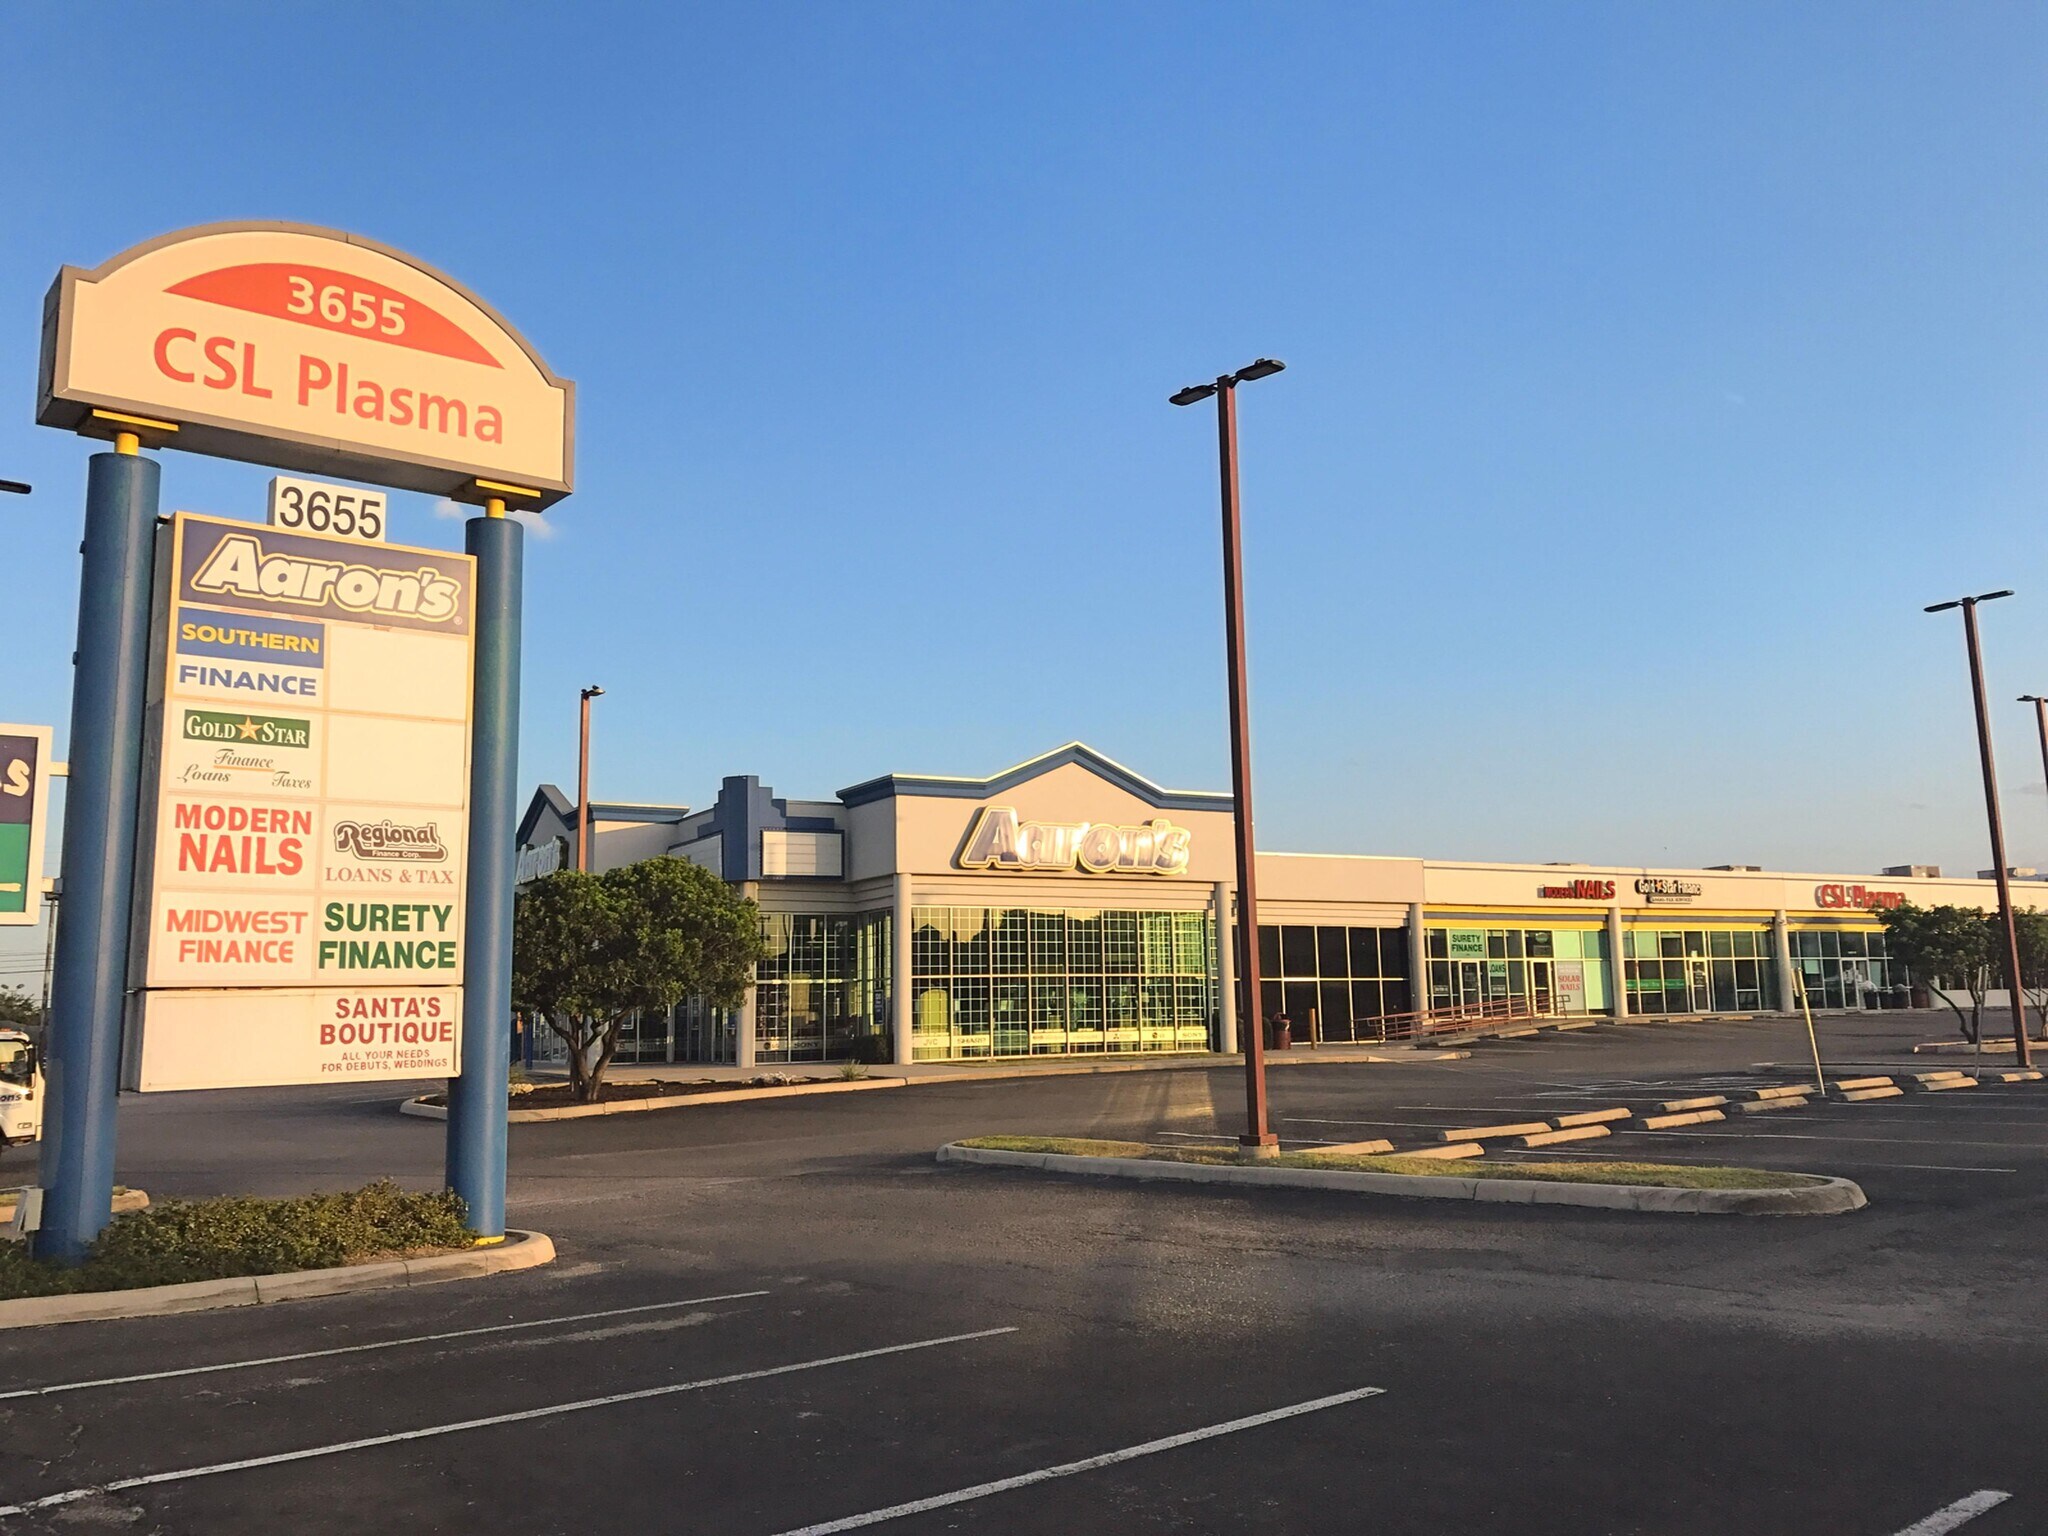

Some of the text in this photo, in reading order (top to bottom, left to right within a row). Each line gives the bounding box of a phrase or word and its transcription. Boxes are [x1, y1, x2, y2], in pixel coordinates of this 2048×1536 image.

[287, 276, 405, 336] 3655
[153, 327, 502, 444] CSL Plasma
[280, 487, 381, 539] 3655
[192, 534, 461, 622] Aaron's
[182, 624, 319, 654] SOUTHERN
[179, 665, 317, 696] FINANCE
[186, 715, 306, 745] GOLD STAR
[214, 748, 274, 769] Finance
[177, 764, 231, 783] Loans
[271, 771, 312, 789] Taxes
[175, 803, 312, 835] MODERN
[334, 820, 440, 851] Regional
[954, 806, 1190, 876] Aaron's
[178, 833, 303, 876] NAILS
[325, 867, 454, 884] LOANS & TAX
[1663, 880, 1677, 894] Star
[1574, 880, 1616, 899] NAILS
[1821, 884, 1851, 908] CSL
[166, 909, 308, 934] MIDWEST
[324, 902, 453, 932] SURETY
[1451, 943, 1483, 952] FINANCE
[1452, 934, 1481, 943] SURETY
[179, 940, 293, 963] FINANCE
[318, 940, 456, 969] FINANCE
[1558, 975, 1581, 983] SOLAR
[1560, 983, 1581, 991] NAILS
[335, 997, 441, 1019] SANTA'S
[320, 1022, 453, 1045] BOUTIQUE
[321, 1058, 448, 1072] FOR DEBUTS, WEDDINGS
[342, 1049, 430, 1061] ALL YOUR NEEDS
